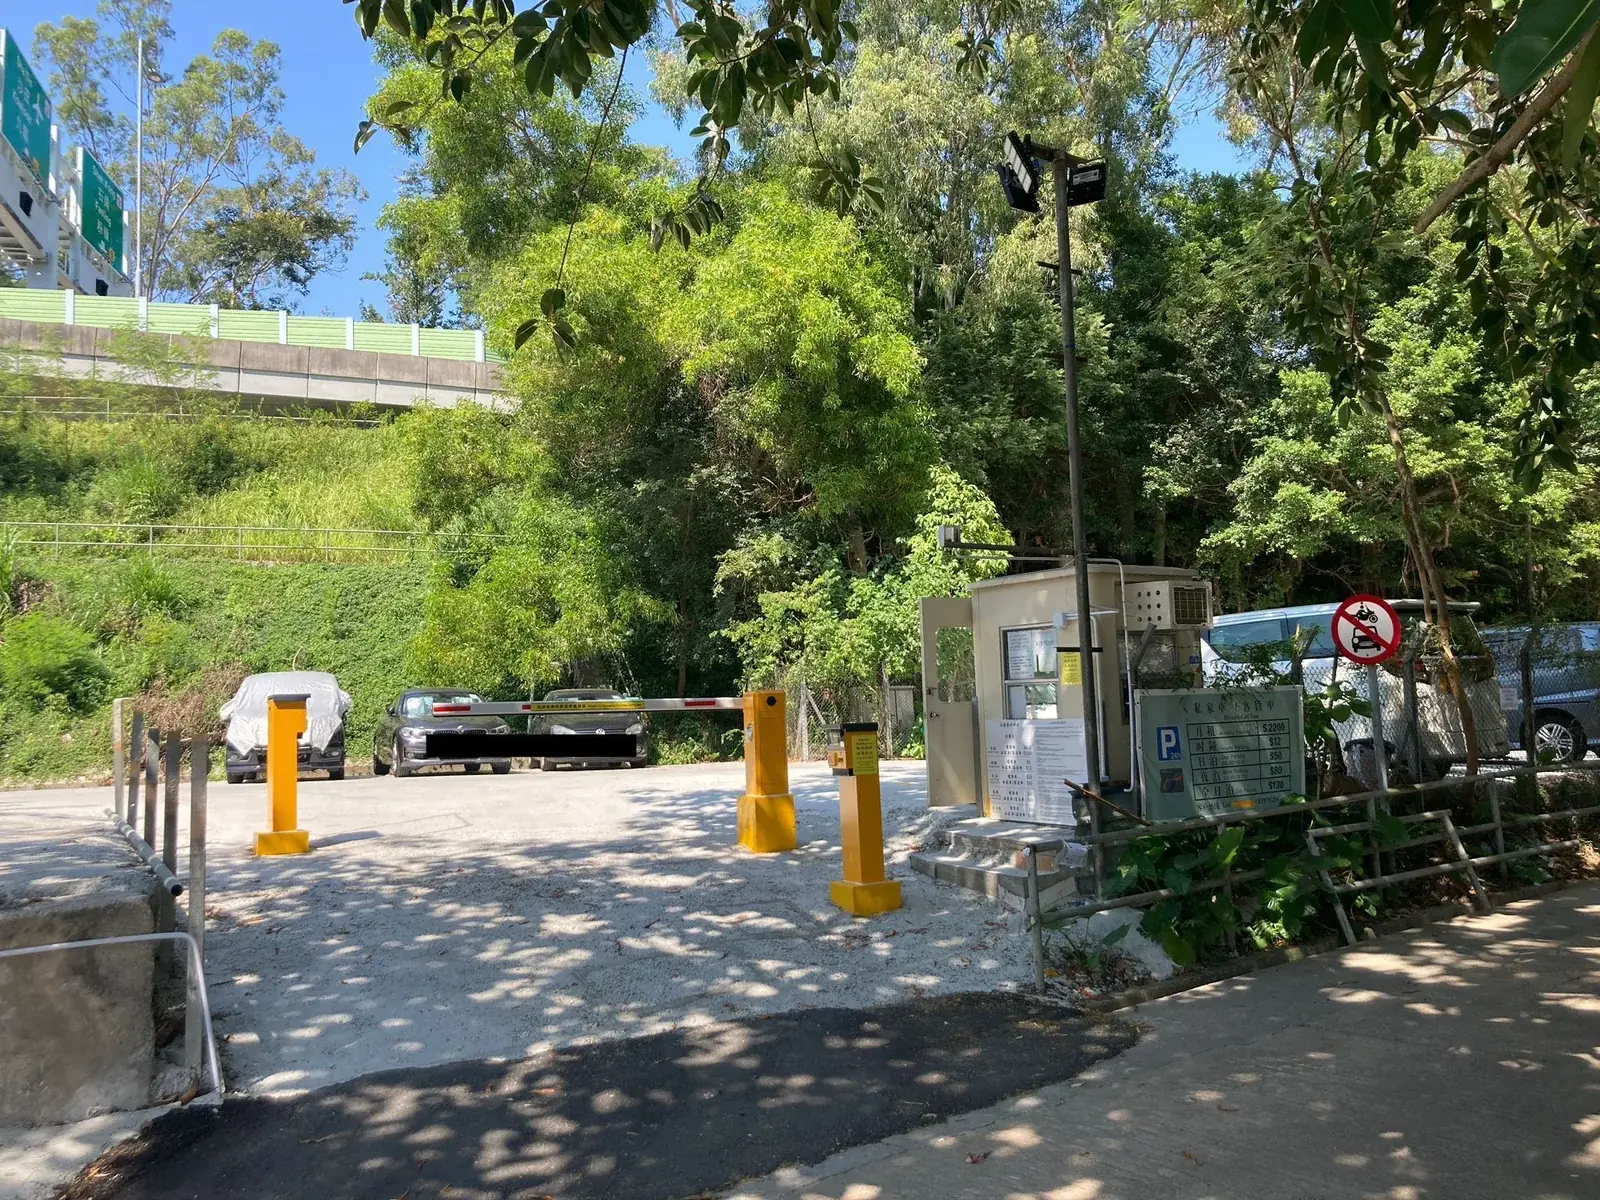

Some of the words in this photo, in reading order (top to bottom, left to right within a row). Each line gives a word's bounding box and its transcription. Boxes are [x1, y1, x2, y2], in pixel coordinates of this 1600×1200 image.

[1263, 722, 1285, 733] $2200
[1161, 729, 1176, 759] P
[1269, 737, 1281, 747] $12
[1269, 751, 1282, 761] $50
[1268, 780, 1284, 791] $130
